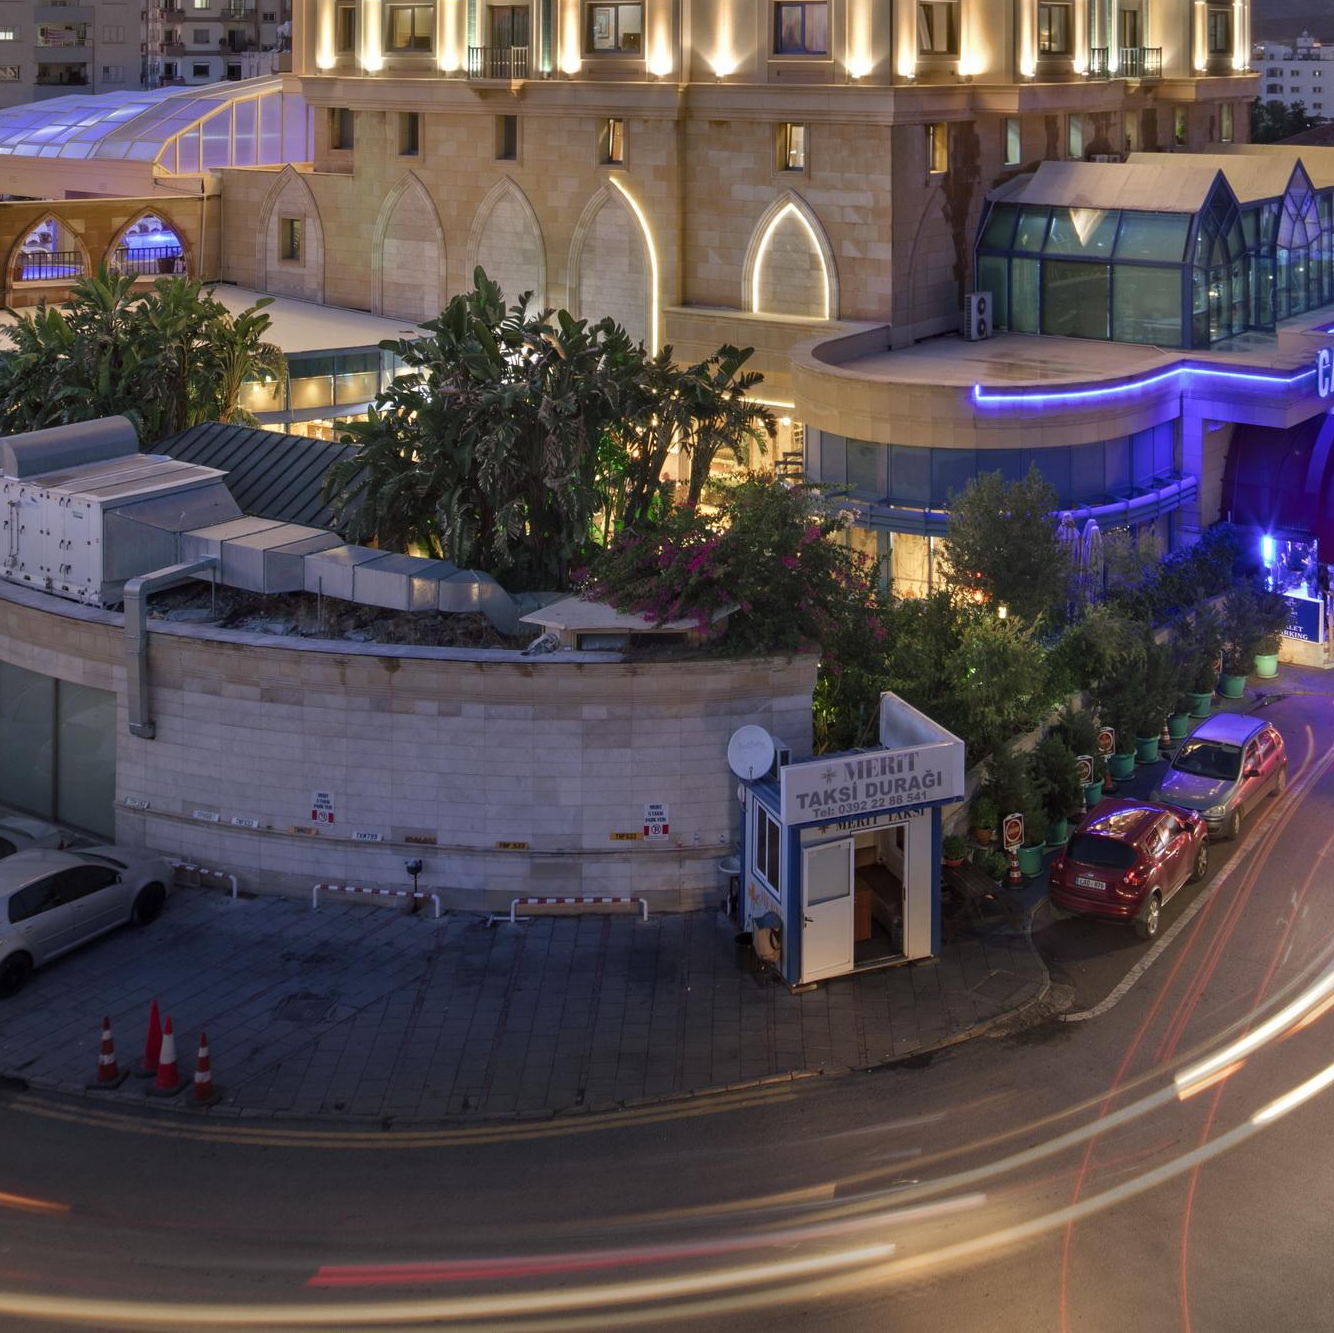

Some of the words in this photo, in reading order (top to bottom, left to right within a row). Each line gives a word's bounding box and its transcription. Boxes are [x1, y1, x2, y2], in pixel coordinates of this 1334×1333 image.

[1281, 630, 1308, 640] RKING
[1286, 625, 1304, 633] LET
[796, 781, 858, 810] TAKSİ
[865, 769, 943, 799] DURAĞI
[813, 807, 835, 819] Tel:
[838, 801, 868, 815] 0392
[871, 798, 885, 809] 22
[889, 795, 904, 806] 88
[907, 790, 928, 803] 541
